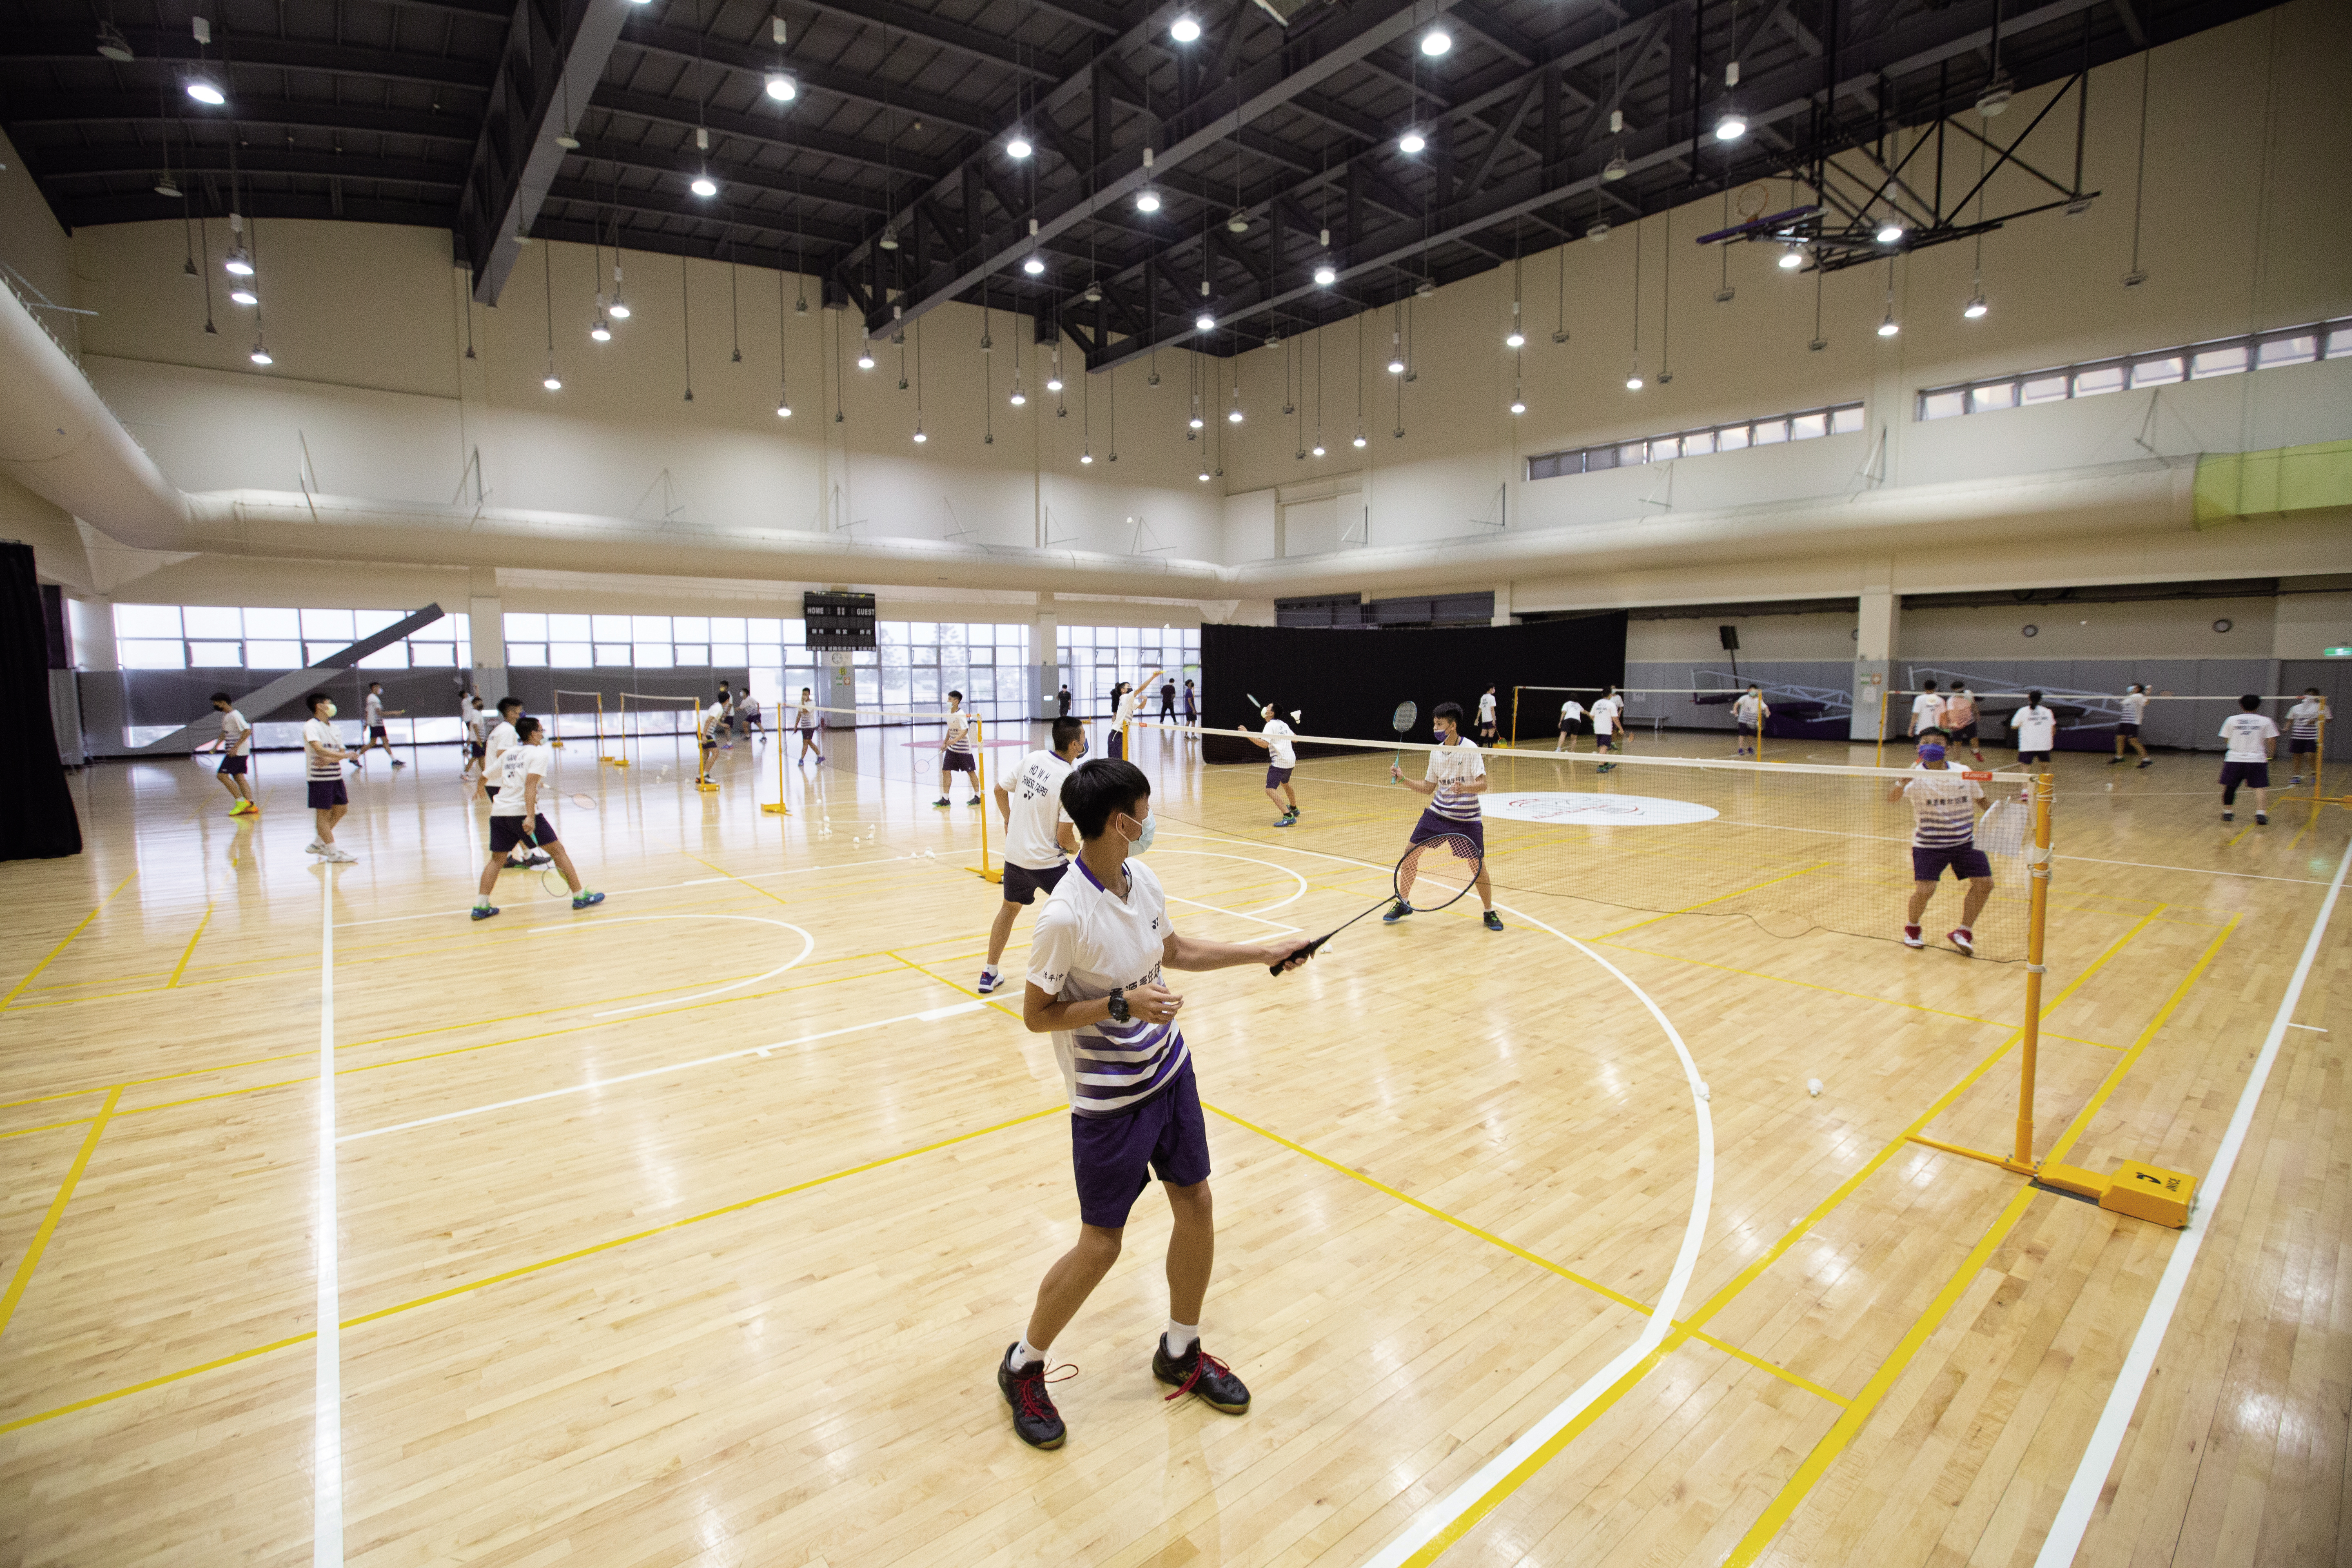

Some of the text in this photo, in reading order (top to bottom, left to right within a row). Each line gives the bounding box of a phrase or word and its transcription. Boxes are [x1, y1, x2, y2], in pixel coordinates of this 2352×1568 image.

[1029, 763, 1051, 783] HO W H
[1034, 783, 1048, 797] TAIPEI
